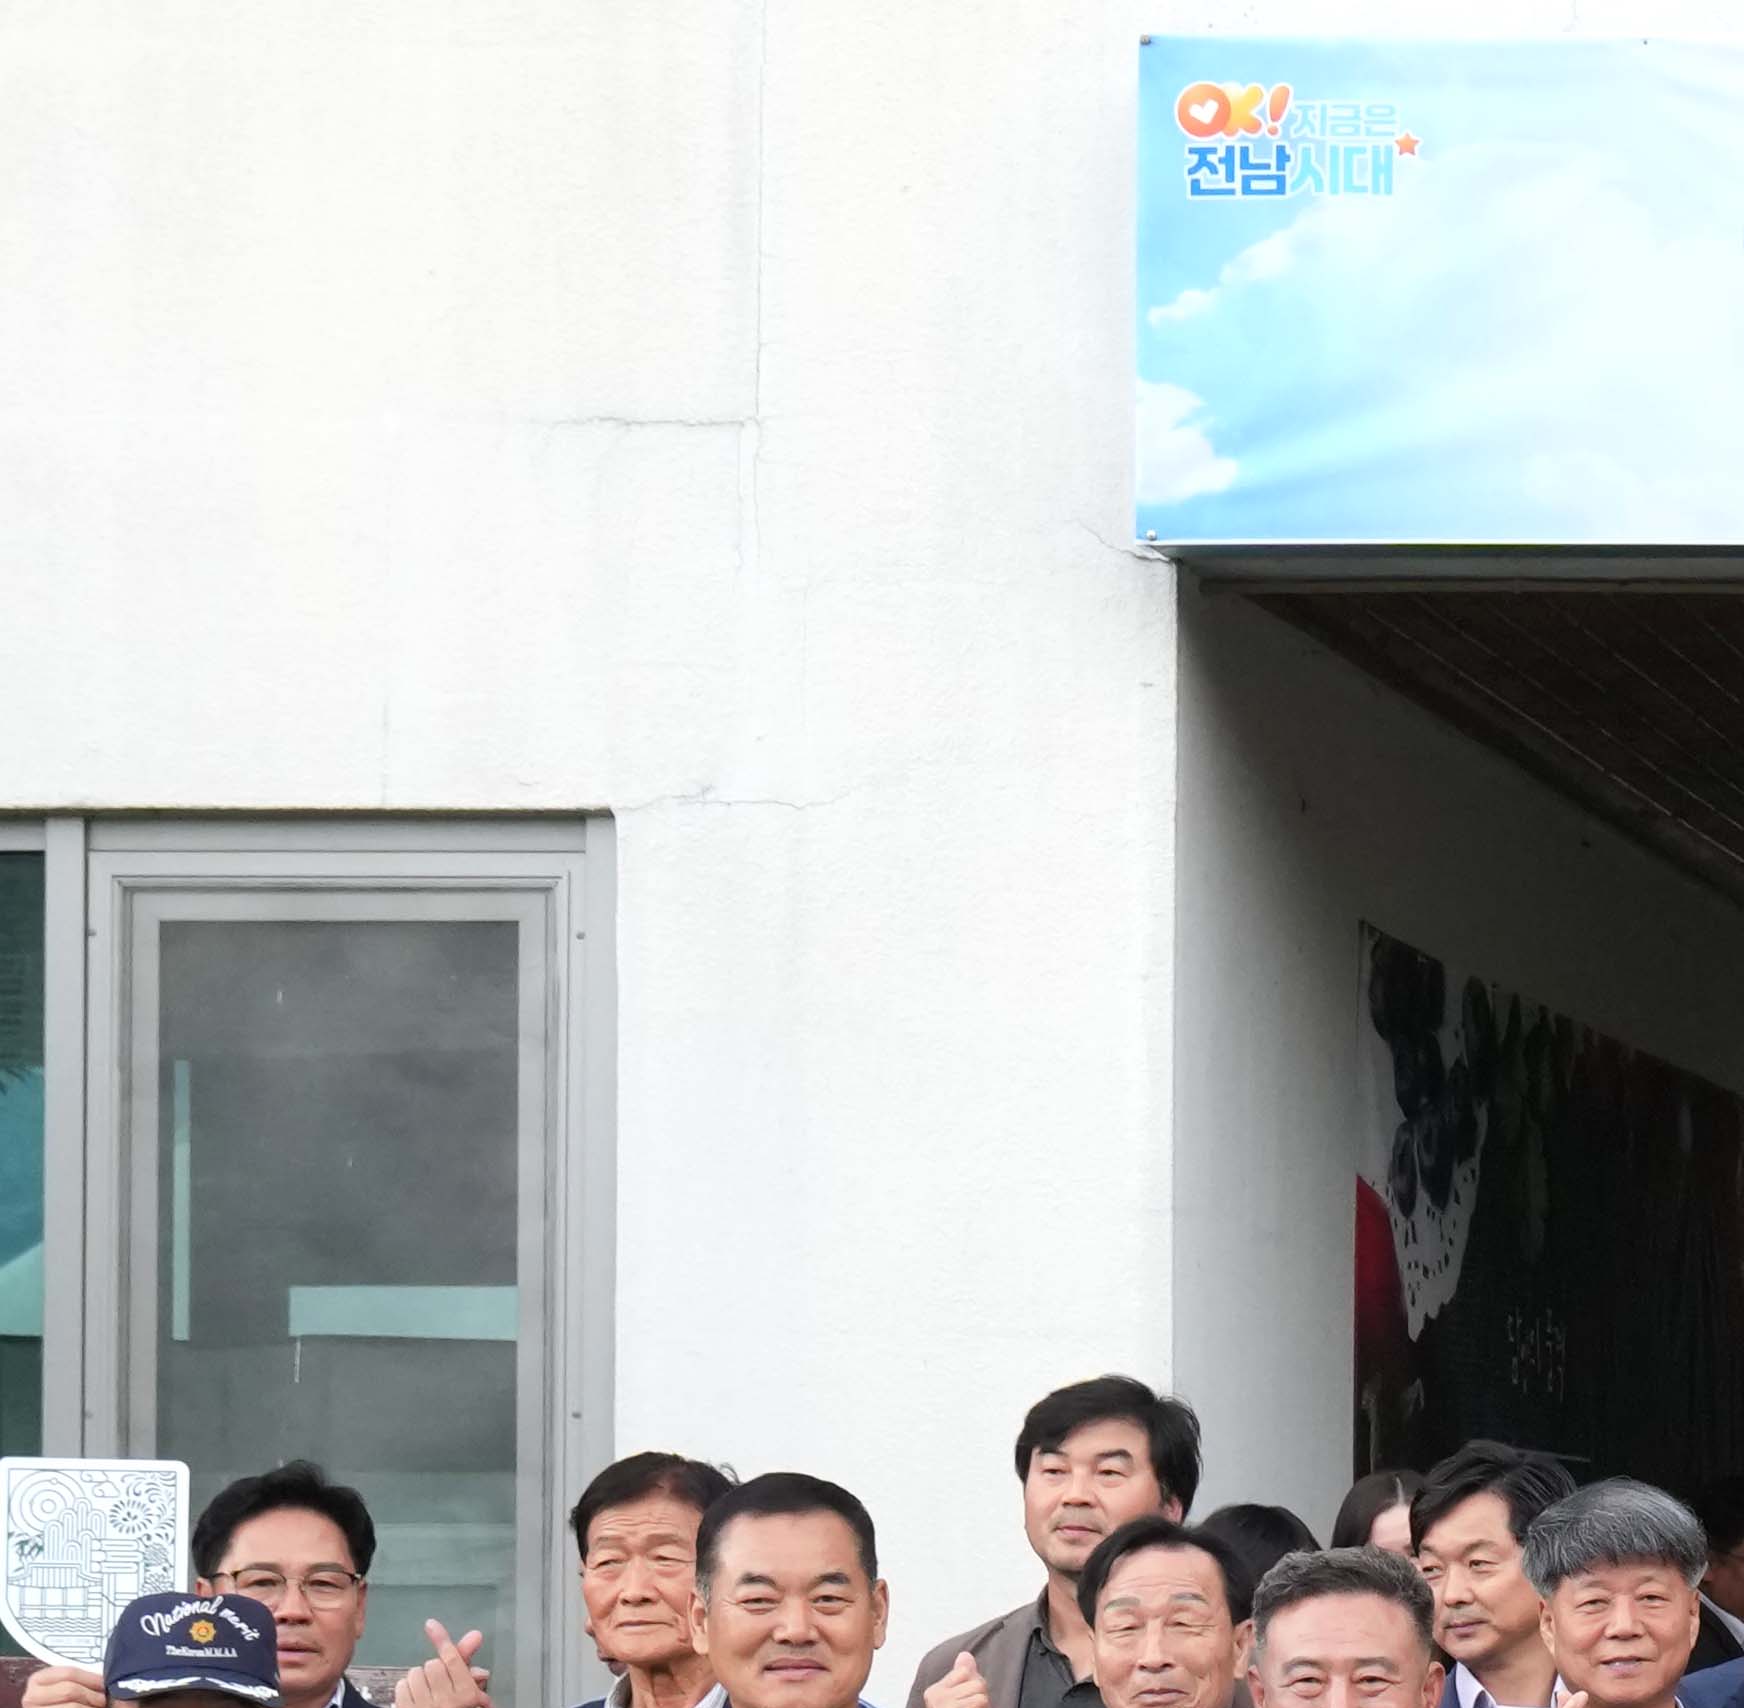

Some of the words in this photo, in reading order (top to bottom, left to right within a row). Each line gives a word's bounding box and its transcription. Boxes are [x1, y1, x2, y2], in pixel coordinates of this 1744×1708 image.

[1177, 83, 1290, 138] OK!
[1290, 103, 1396, 138] 지금은
[1187, 143, 1393, 196] 전남시대
